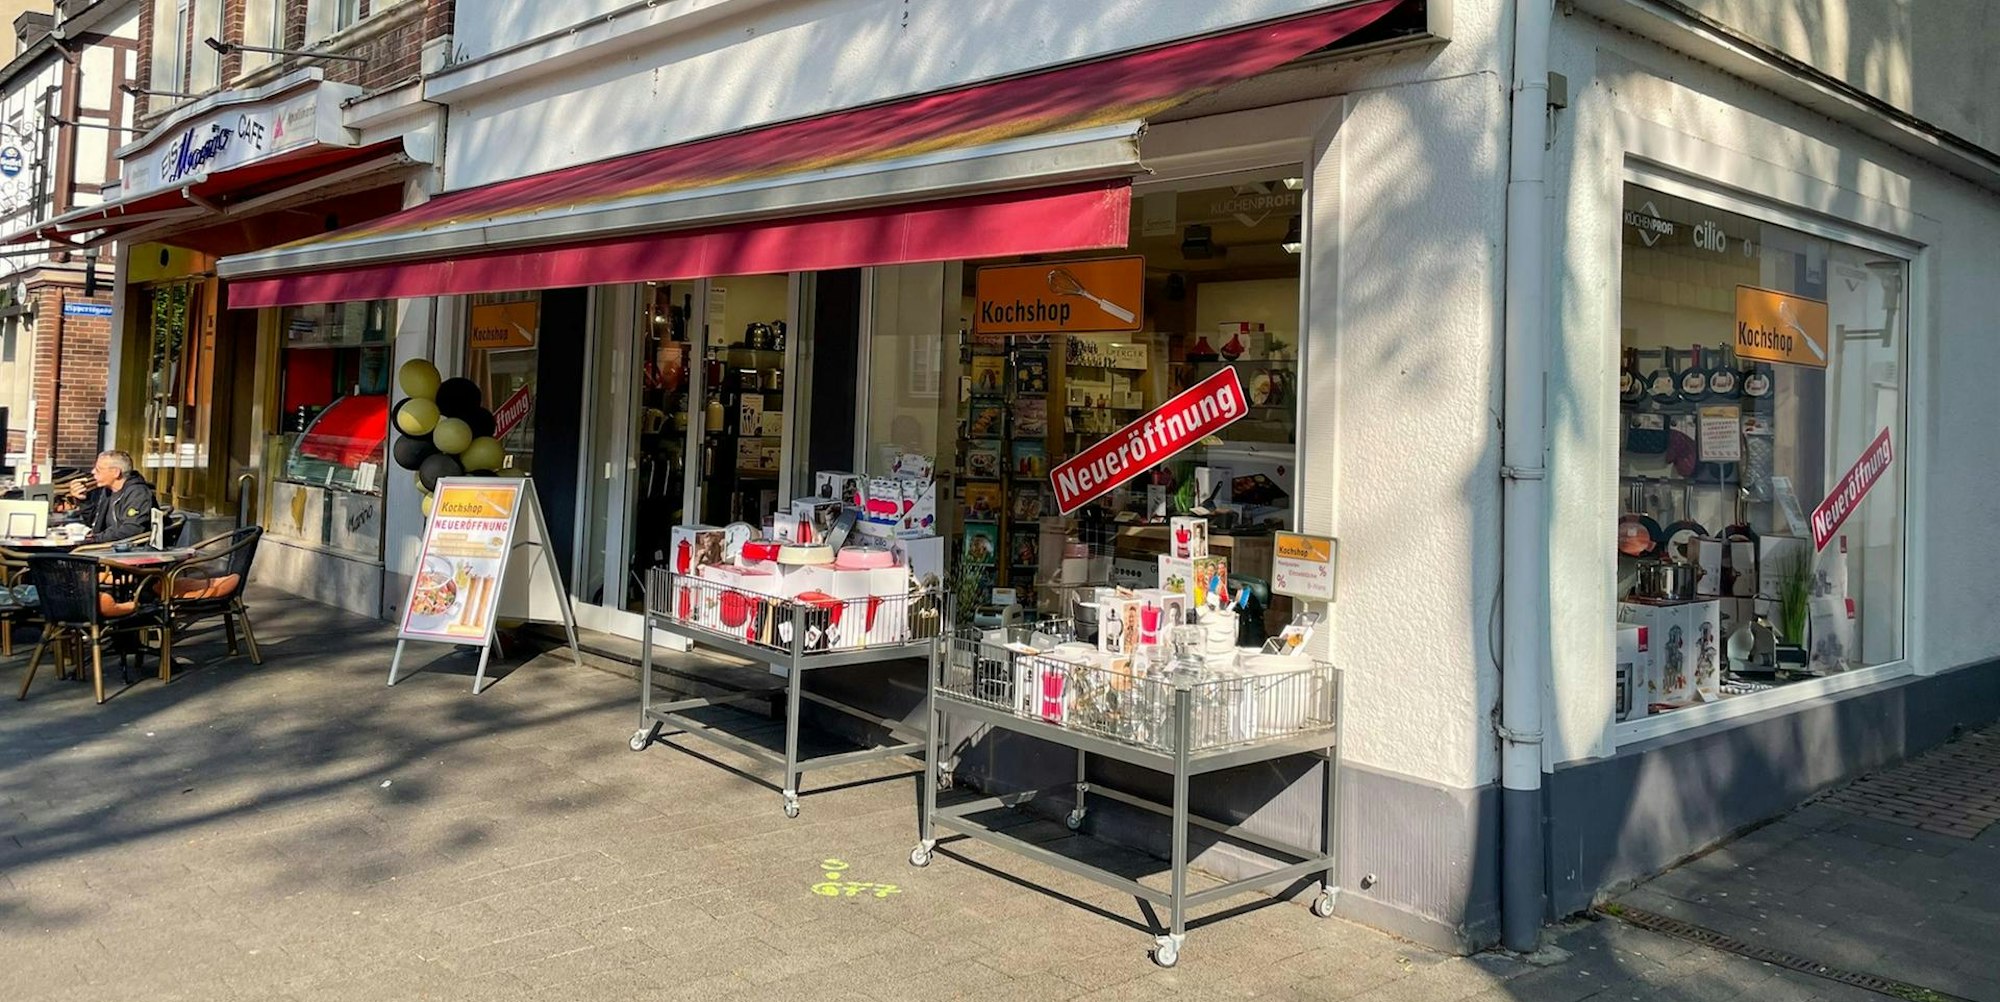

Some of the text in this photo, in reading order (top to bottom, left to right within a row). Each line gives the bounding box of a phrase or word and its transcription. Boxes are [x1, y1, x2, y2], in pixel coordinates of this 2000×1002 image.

[161, 140, 178, 179] EIS
[237, 113, 266, 151] CAFE
[1693, 220, 1727, 253] cilio
[981, 298, 1071, 325] Kochshop
[473, 326, 509, 342] Kochshop
[1738, 321, 1793, 356] Kochshop
[1057, 383, 1238, 503] Neueröffnung
[1813, 438, 1891, 542] Neueröffnung
[441, 502, 483, 514] Kochshop
[434, 519, 508, 532] NEUERÖFFNUNG
[1278, 546, 1309, 557] Kochshop
